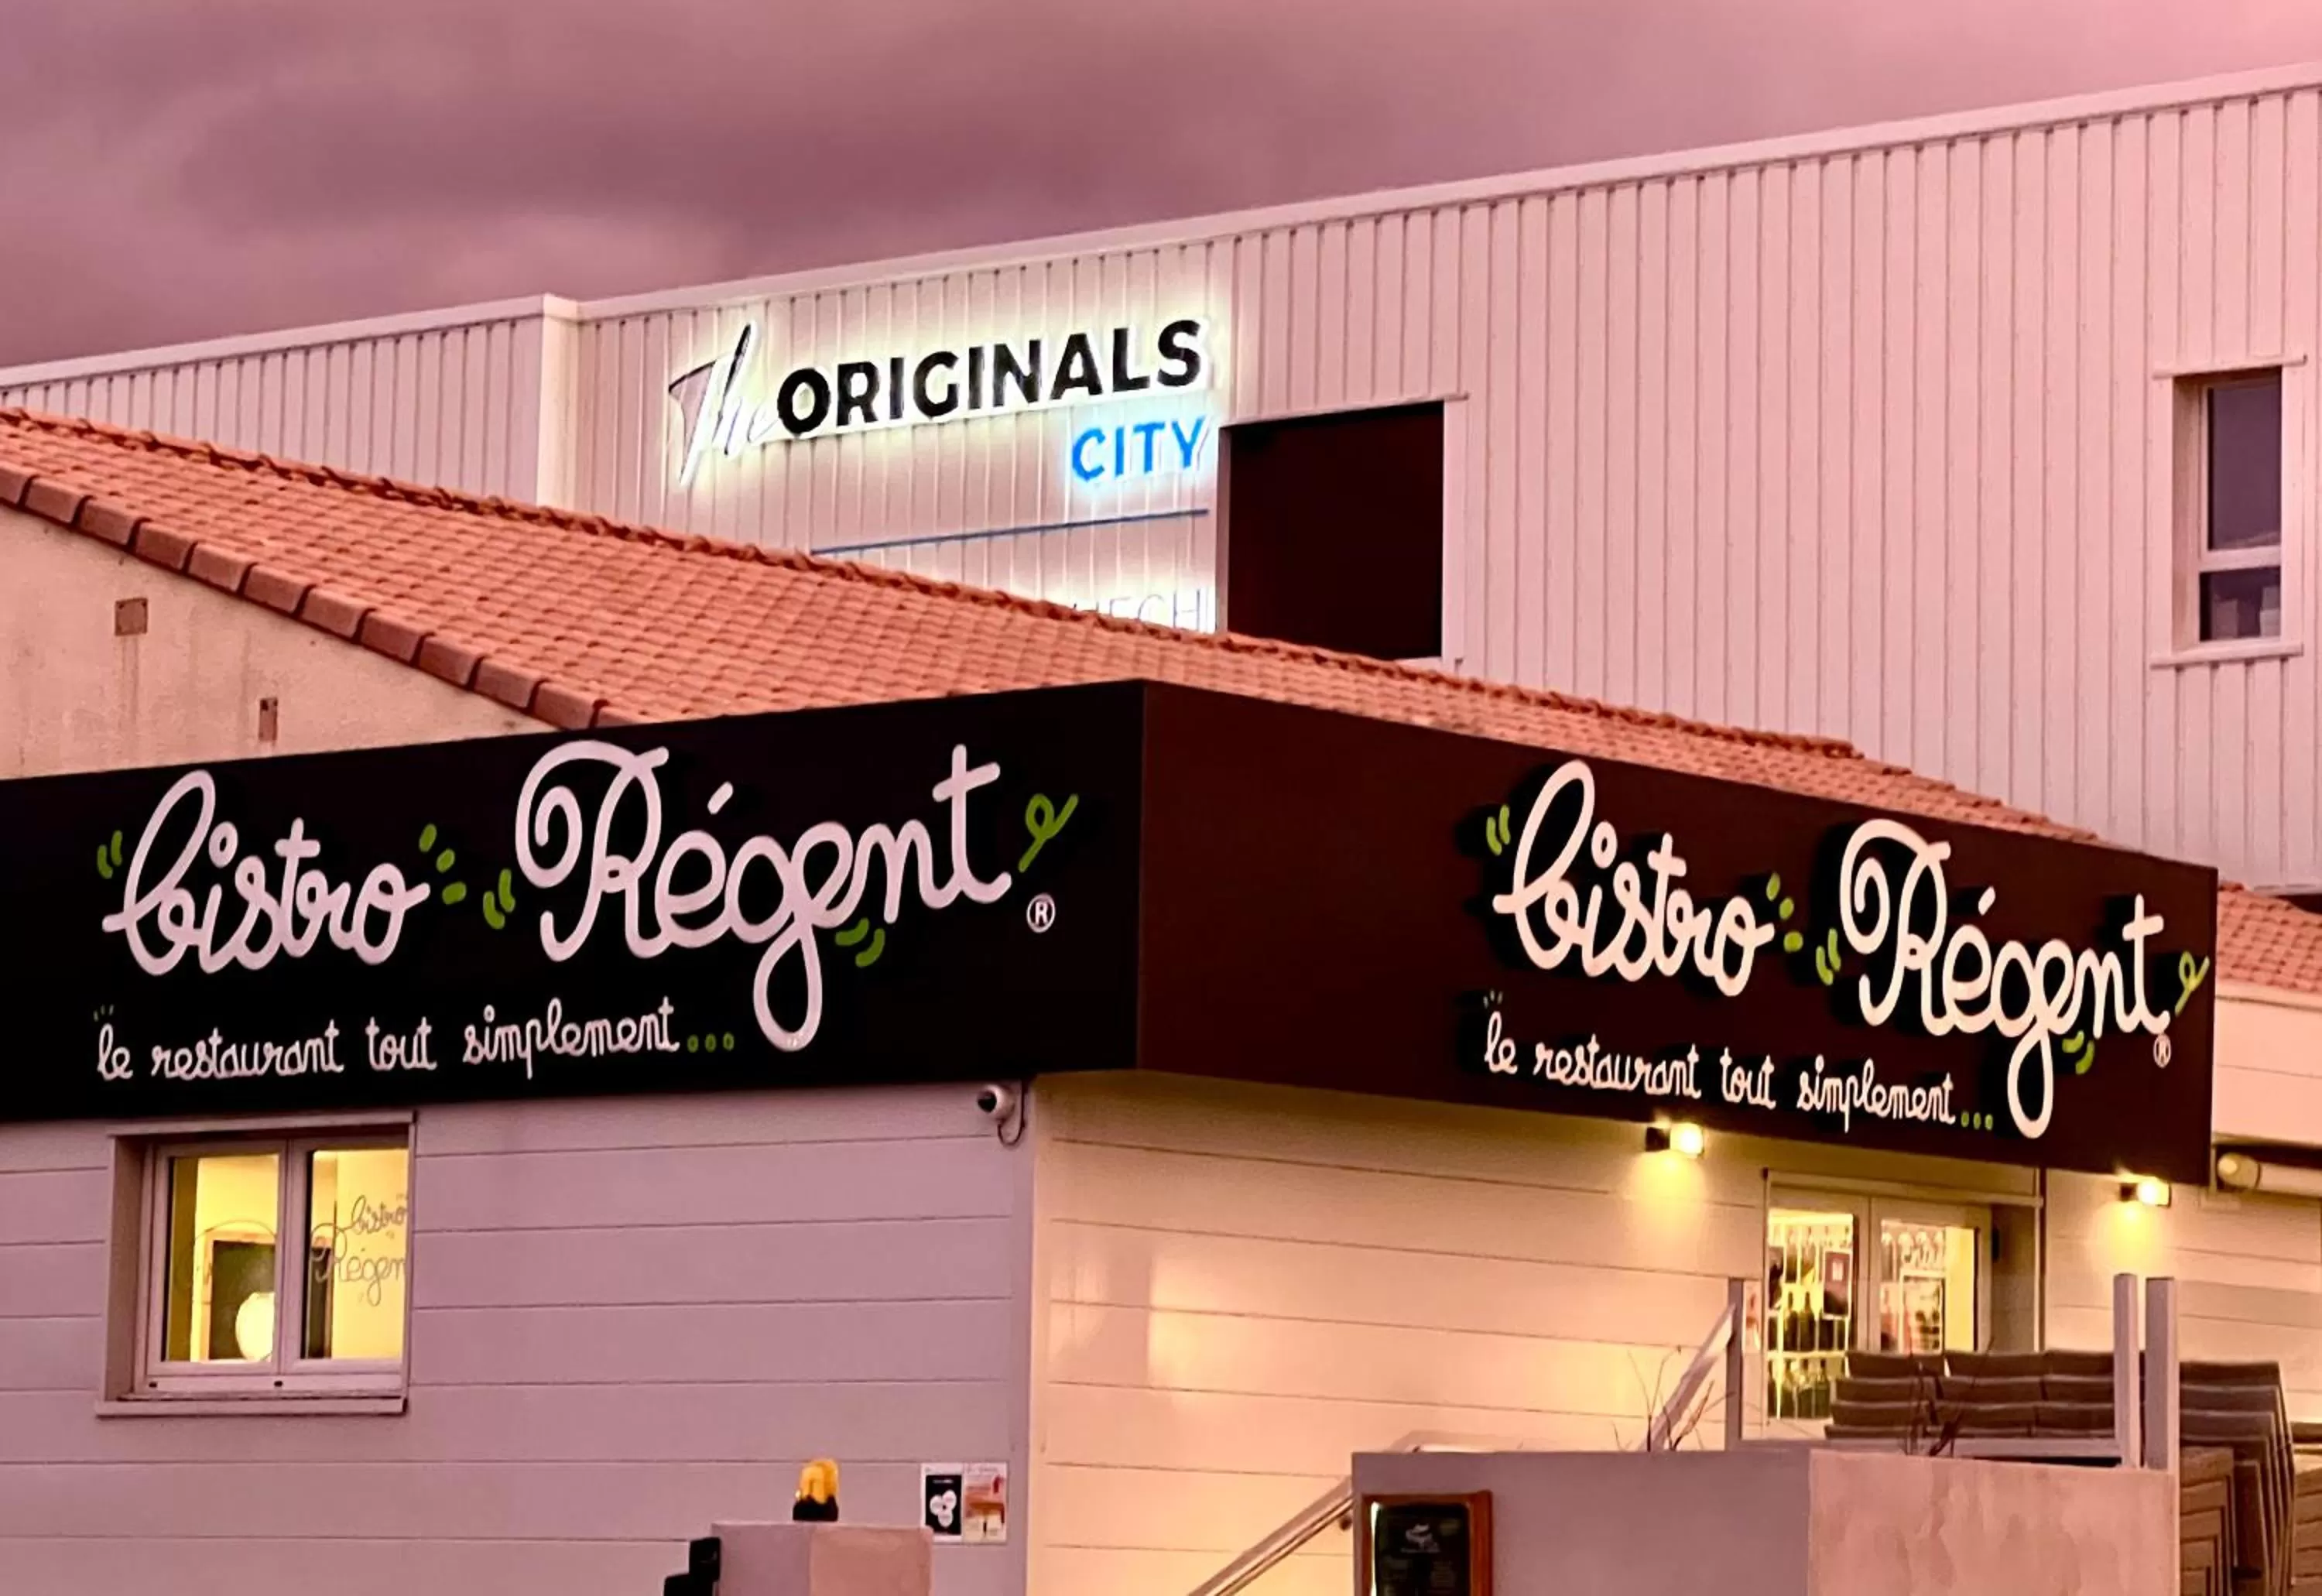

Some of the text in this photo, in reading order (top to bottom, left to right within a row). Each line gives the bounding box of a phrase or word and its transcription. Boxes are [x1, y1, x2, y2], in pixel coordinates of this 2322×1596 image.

[669, 319, 1204, 485] The ORIGINALS
[1070, 416, 1206, 483] CITY
[101, 740, 1012, 1052] bistro Régent
[1492, 759, 2171, 1139] bistro Régent
[97, 1023, 133, 1081] le
[151, 1019, 344, 1081] restaurant
[365, 1016, 437, 1071] tout
[1484, 1011, 1518, 1074] le
[1533, 1033, 1702, 1100] restaurant
[1719, 1046, 1776, 1110] tout
